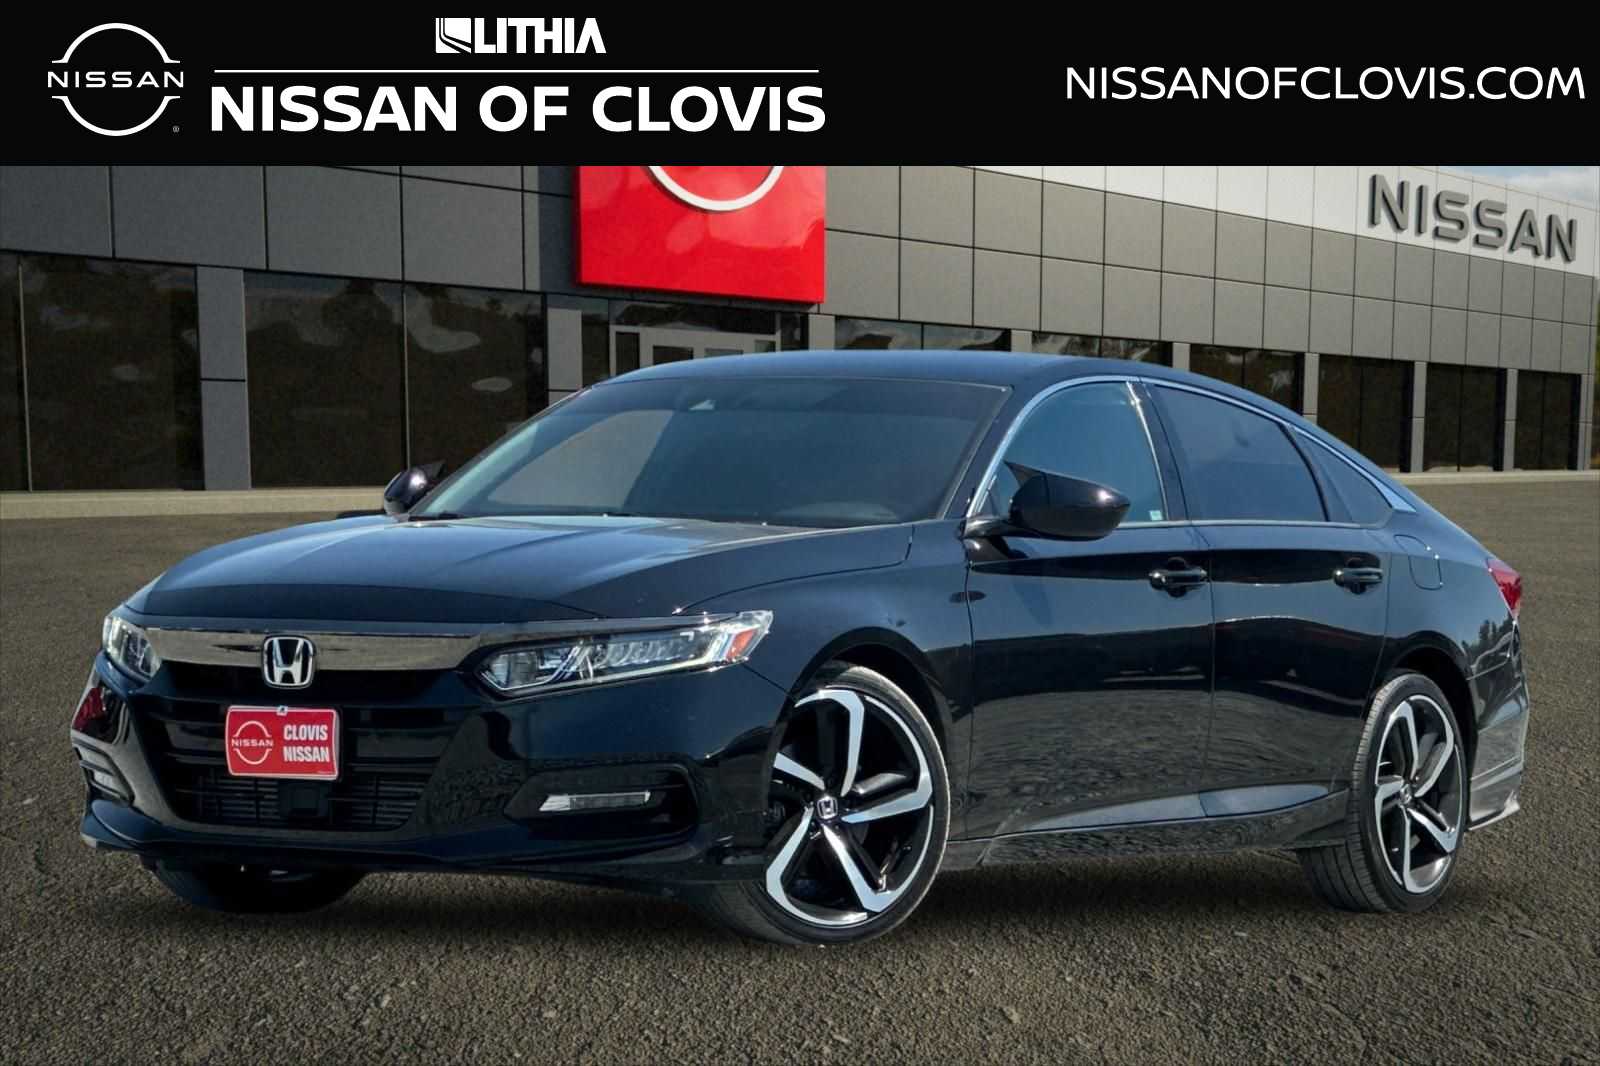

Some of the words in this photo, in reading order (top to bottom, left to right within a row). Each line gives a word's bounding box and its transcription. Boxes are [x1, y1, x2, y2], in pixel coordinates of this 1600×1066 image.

[1368, 174, 1578, 263] NISSAN
[283, 724, 329, 741] CLOVIS
[231, 739, 274, 748] NISSAN
[283, 746, 330, 763] NISSAN
